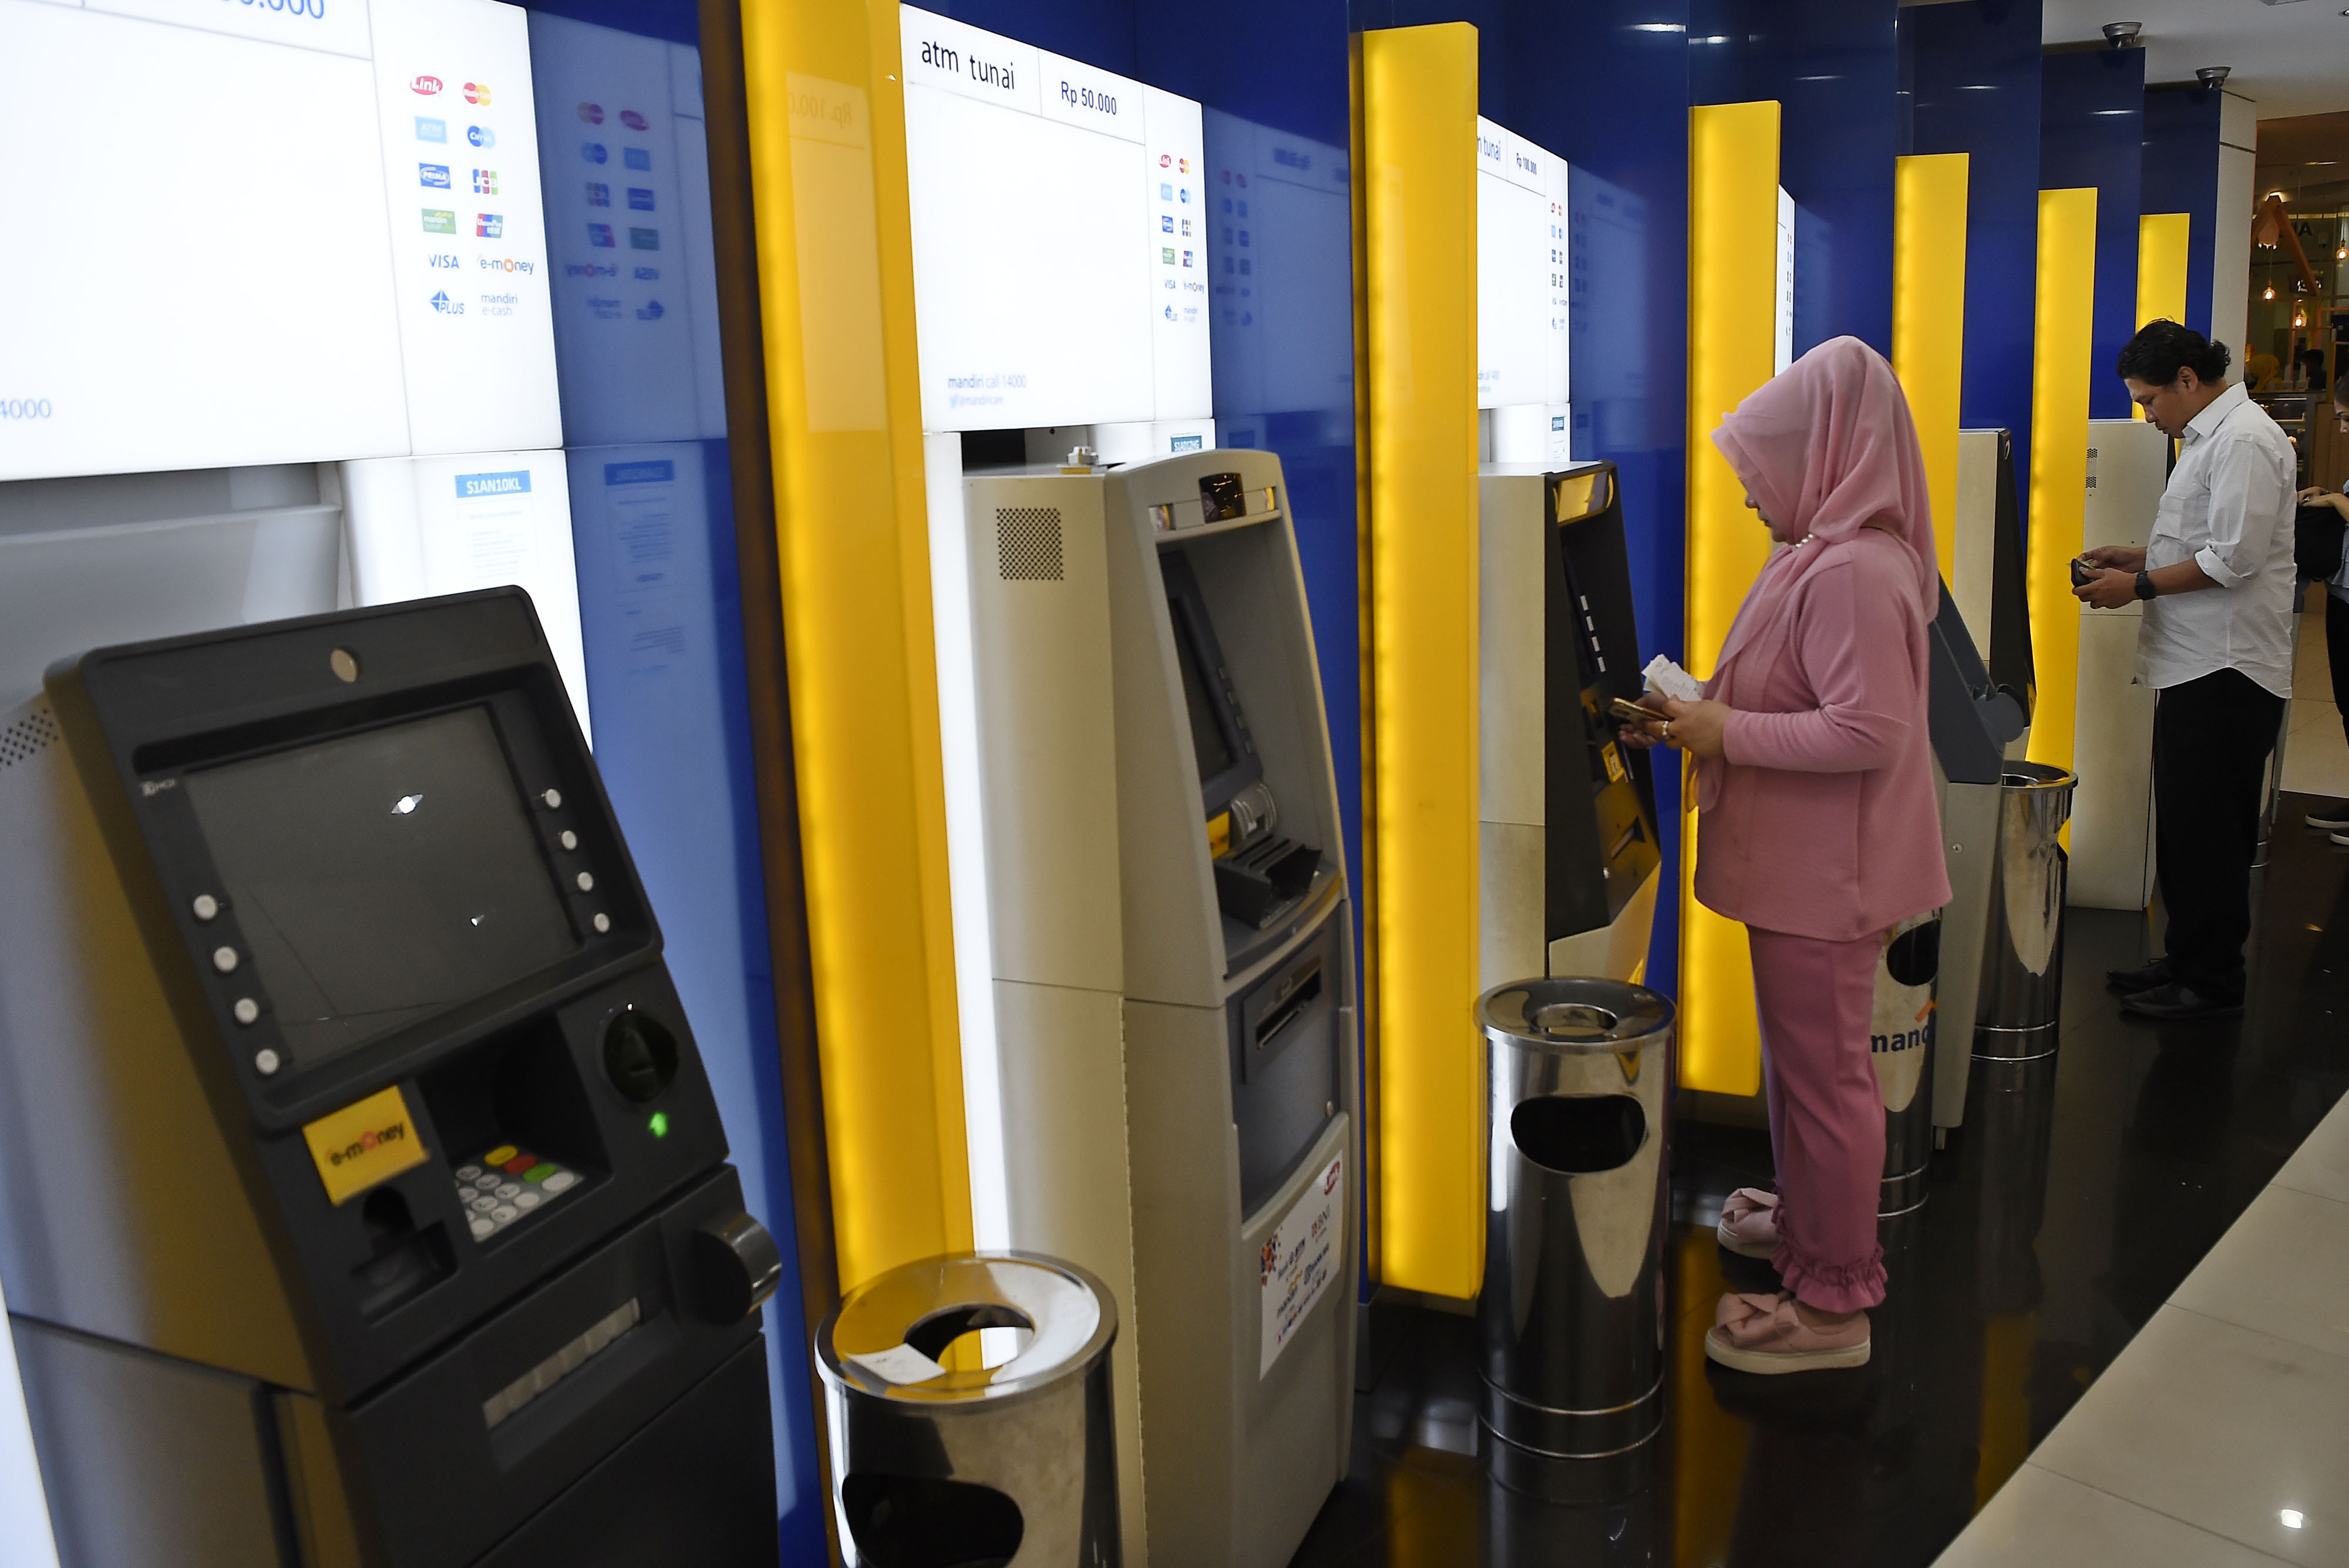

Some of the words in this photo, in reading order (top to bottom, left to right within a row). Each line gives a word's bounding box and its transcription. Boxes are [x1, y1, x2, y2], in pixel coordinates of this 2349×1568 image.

[921, 41, 958, 72] atm
[970, 55, 1014, 90] tunai
[411, 75, 440, 96] Link
[1061, 81, 1077, 107] Rp
[1082, 88, 1116, 116] 50.000
[1483, 136, 1500, 162] tunai
[422, 171, 446, 181] PRIMA
[429, 254, 460, 269] VISA
[480, 258, 534, 275] e-money
[481, 293, 518, 304] mandiri
[440, 302, 465, 315] PLUS
[482, 305, 512, 316] e-cash
[948, 374, 984, 388] mandiri
[466, 477, 522, 494] S1AN10KL
[329, 1122, 405, 1167] e-money
